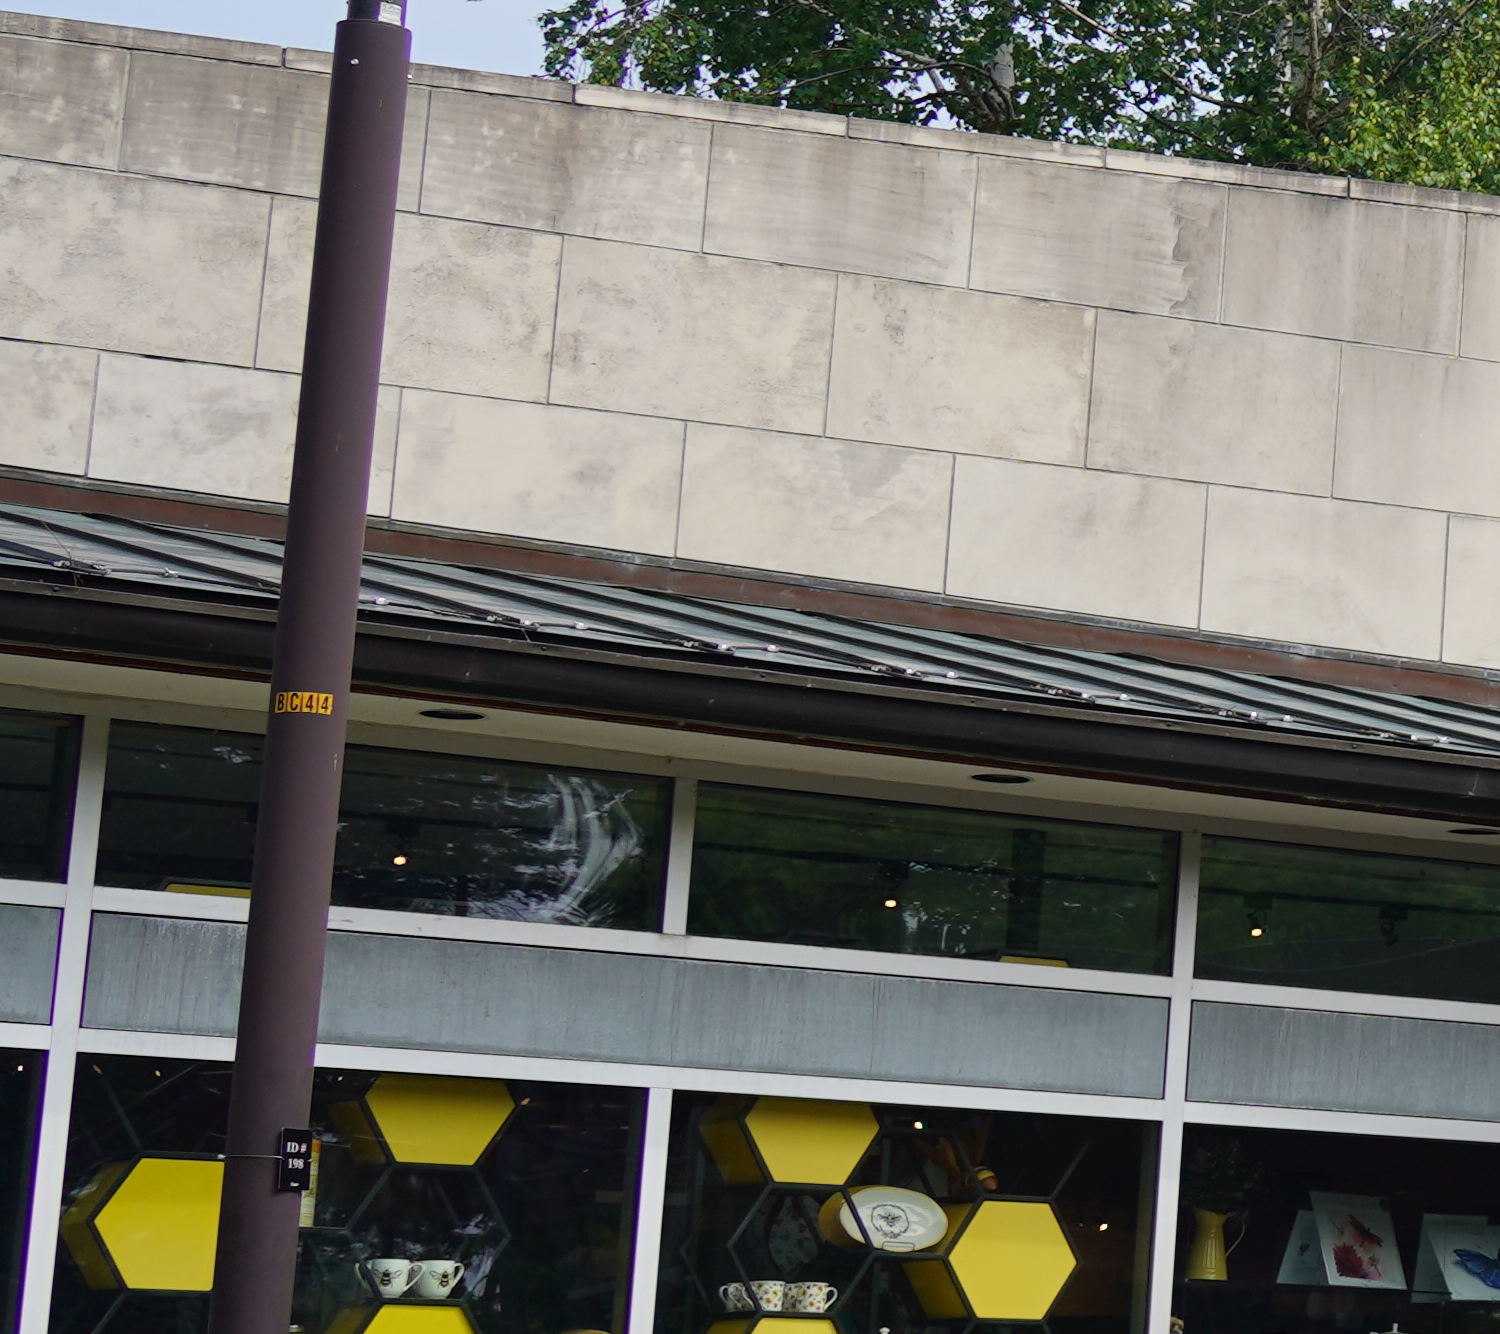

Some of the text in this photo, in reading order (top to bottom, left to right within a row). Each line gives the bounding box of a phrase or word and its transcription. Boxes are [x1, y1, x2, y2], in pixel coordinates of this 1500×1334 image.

[277, 693, 329, 713] BC44
[287, 1142, 299, 1153] ID
[288, 1158, 305, 1169] 198
